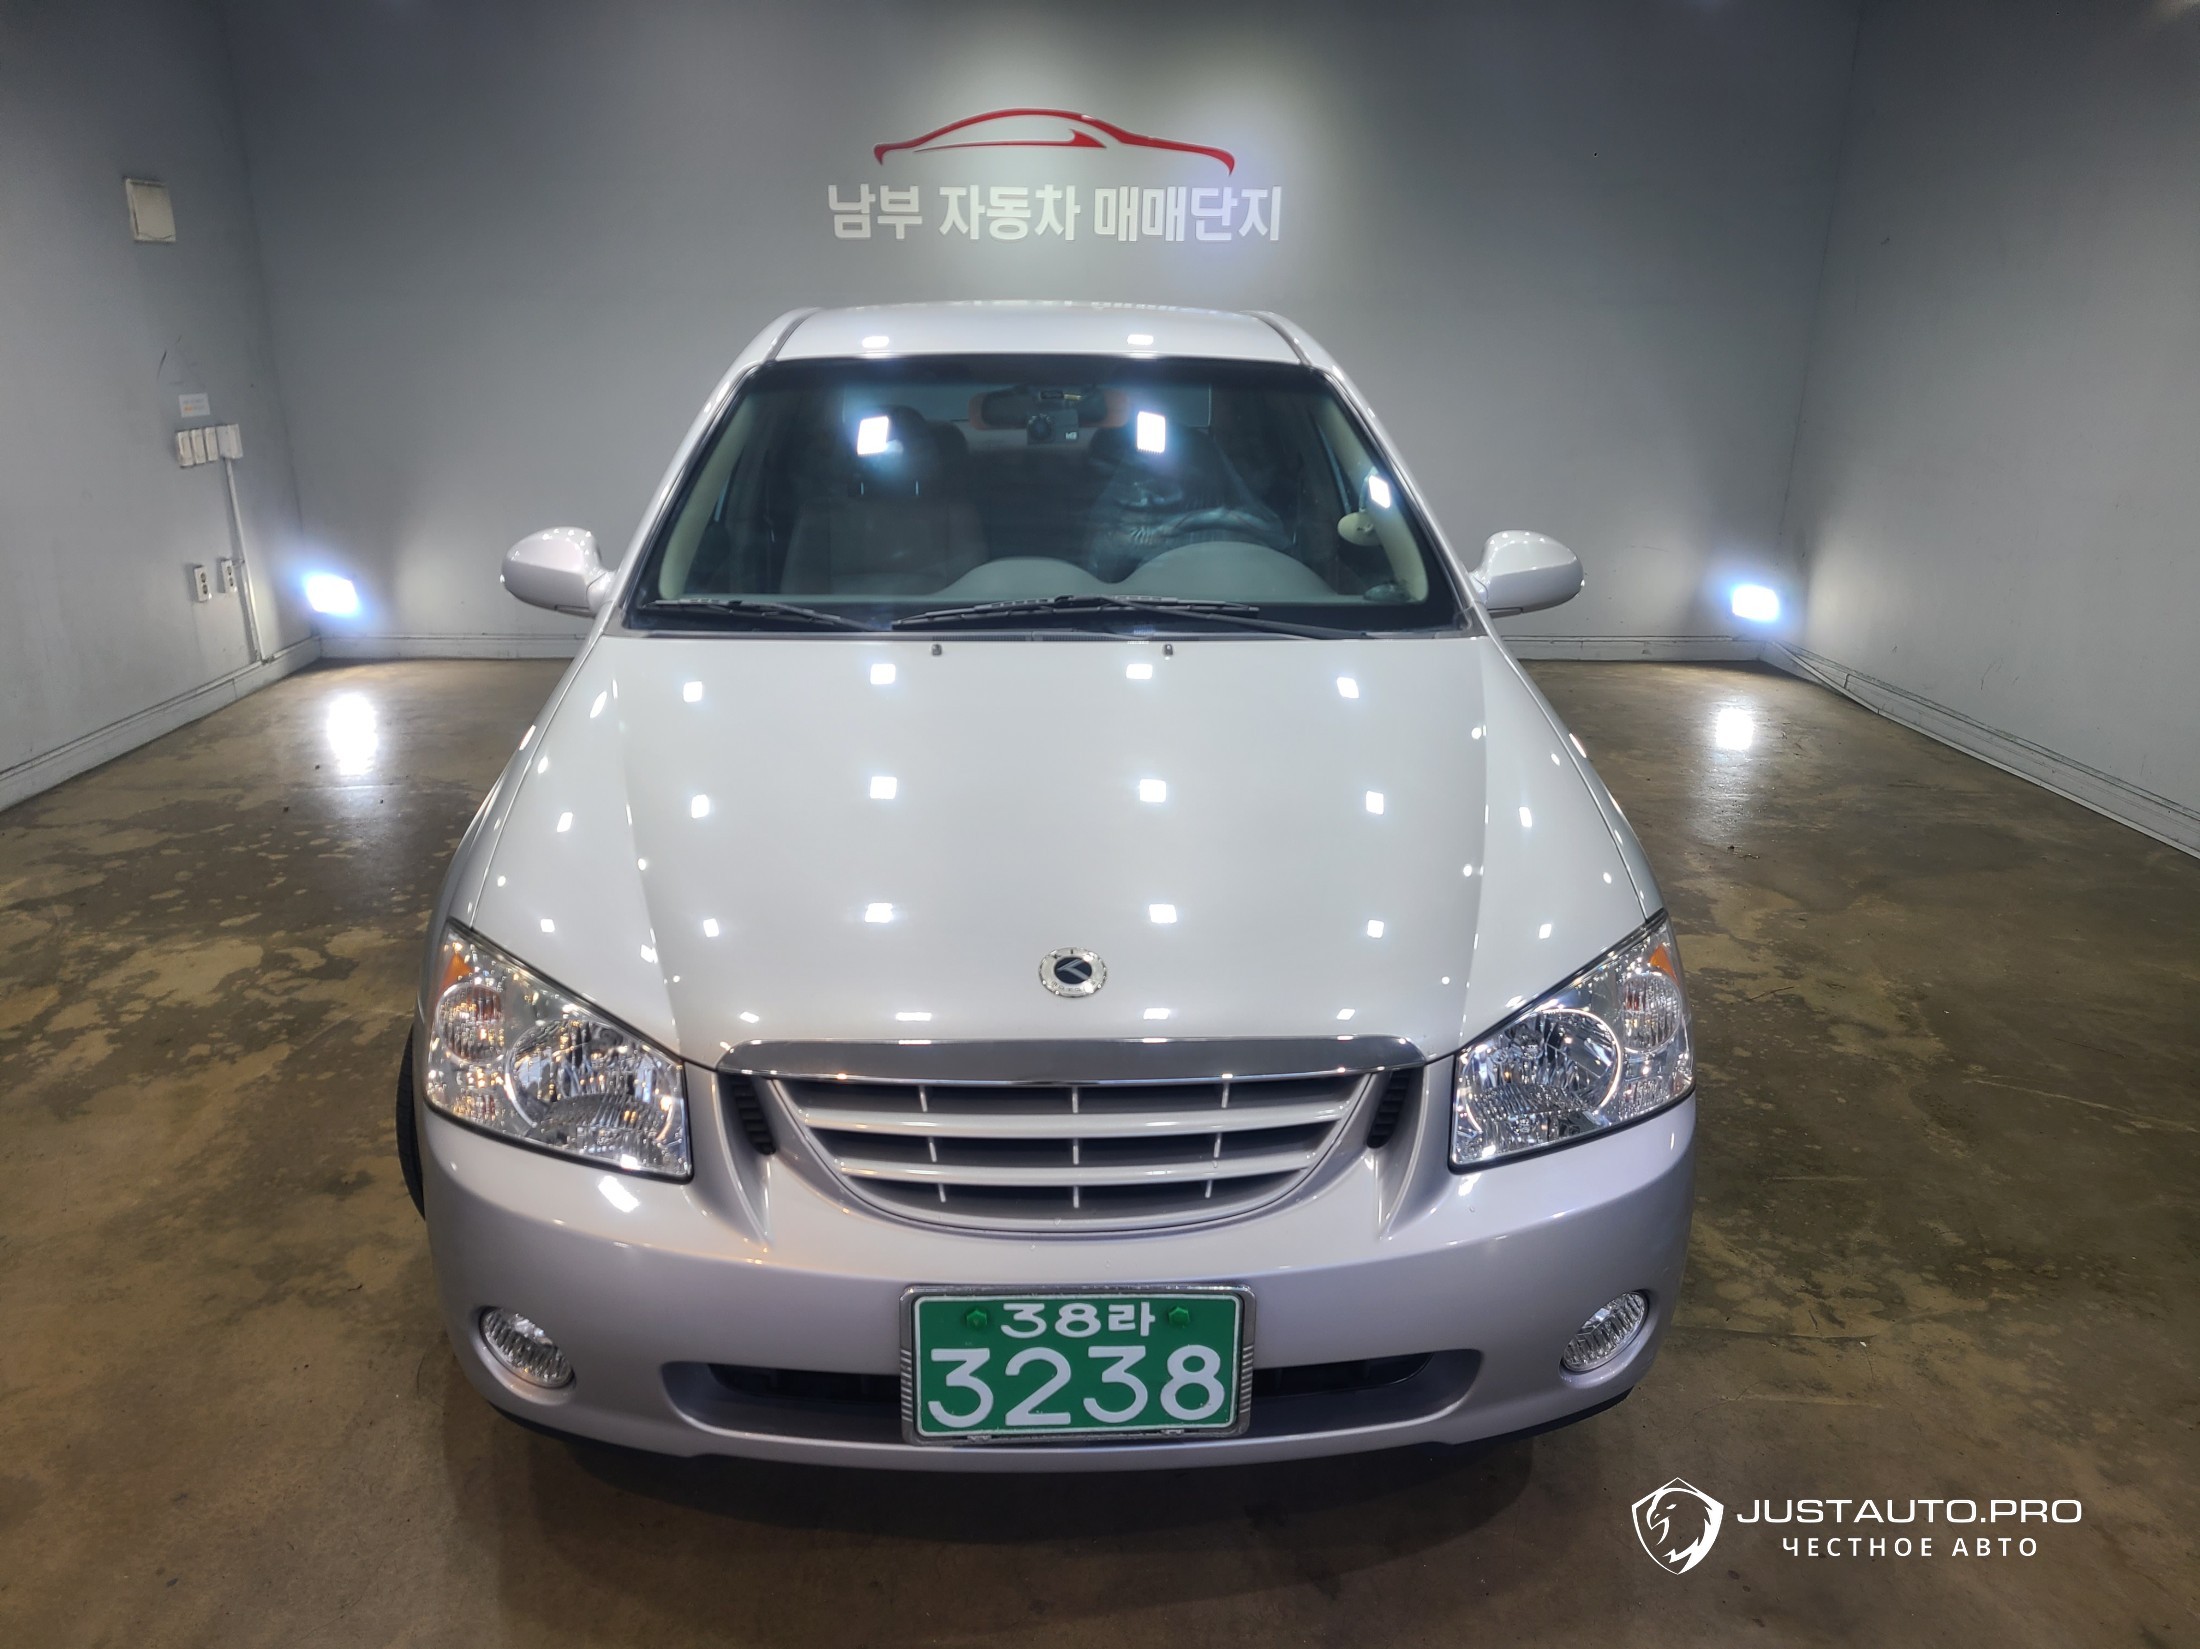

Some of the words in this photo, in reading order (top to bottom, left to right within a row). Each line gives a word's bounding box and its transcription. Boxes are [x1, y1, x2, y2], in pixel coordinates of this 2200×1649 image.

[827, 183, 924, 240] 남부
[938, 184, 1082, 241] 자동차
[1093, 184, 1283, 242] 매매단지
[1000, 1301, 1156, 1339] 38라
[927, 1344, 1226, 1428] 3238
